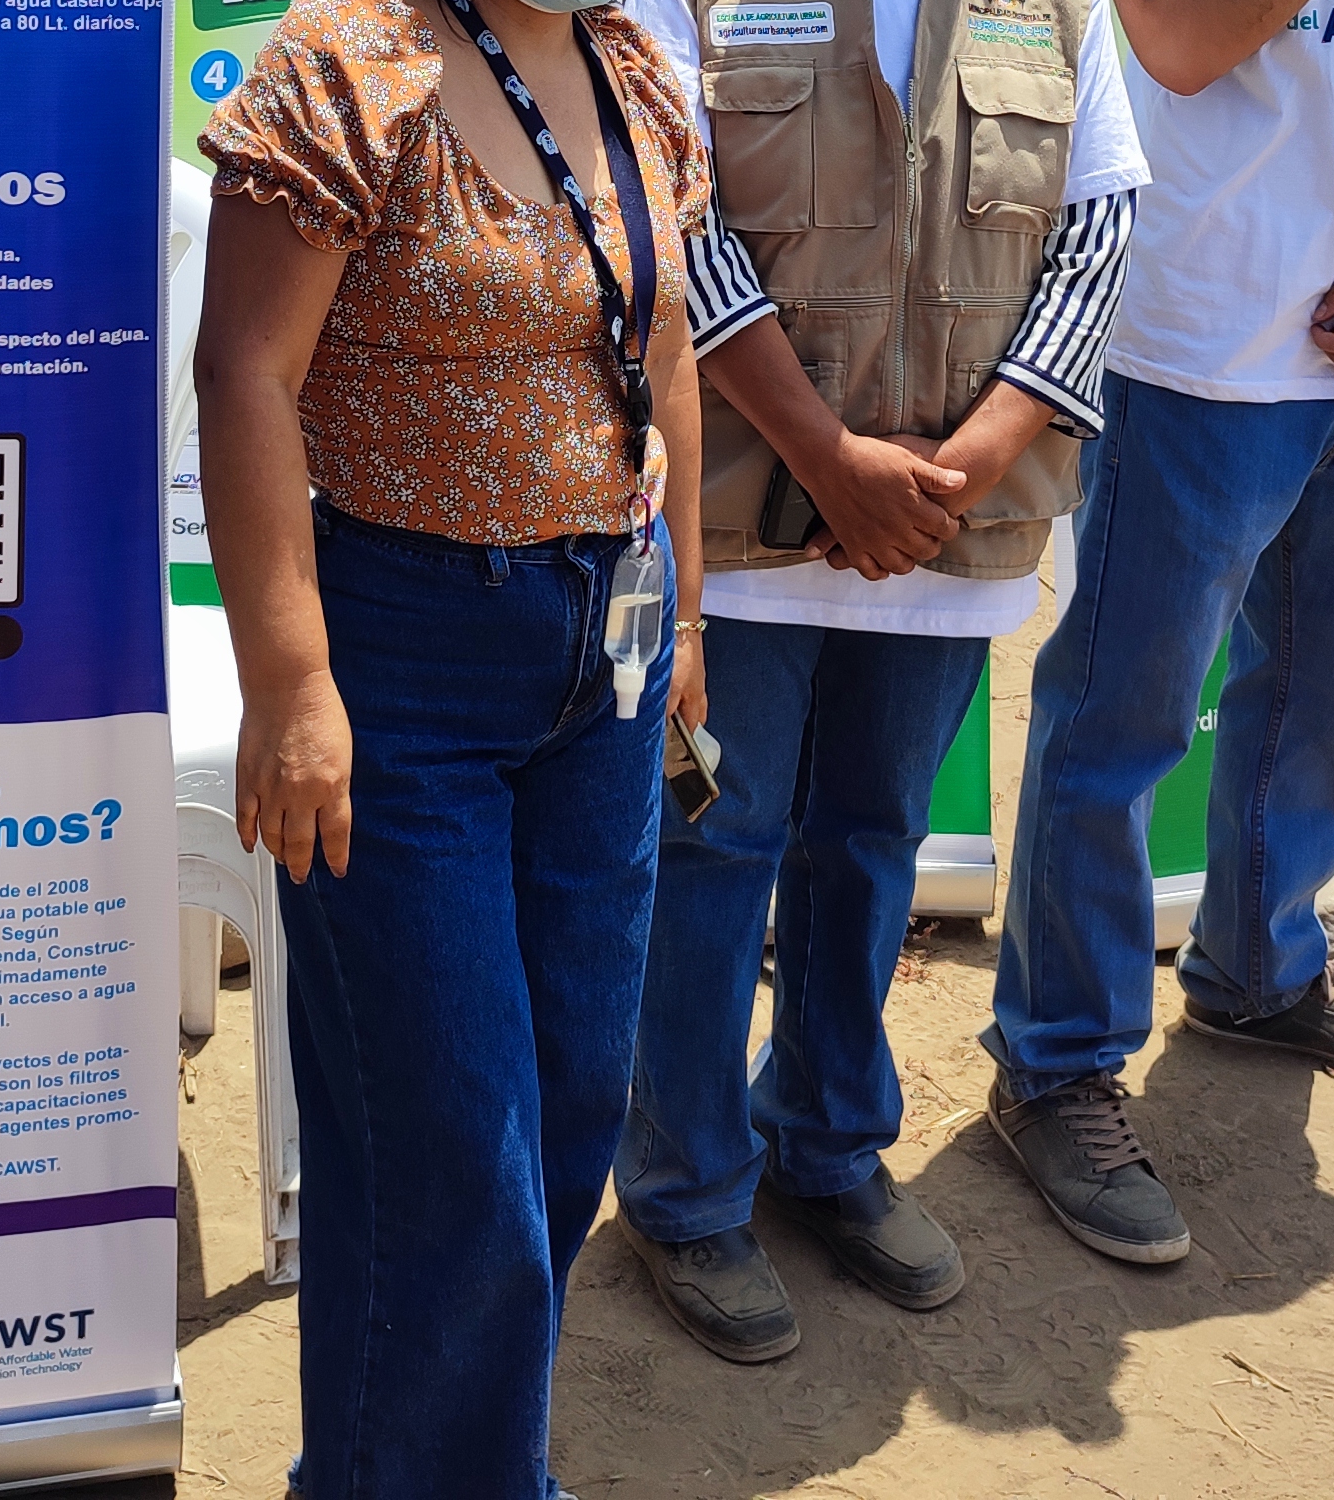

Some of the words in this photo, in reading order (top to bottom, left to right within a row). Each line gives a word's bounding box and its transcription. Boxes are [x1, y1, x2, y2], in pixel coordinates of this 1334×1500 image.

[746, 13, 755, 21] DE
[203, 60, 227, 90] 4
[27, 882, 41, 897] el
[48, 879, 88, 895] 2008
